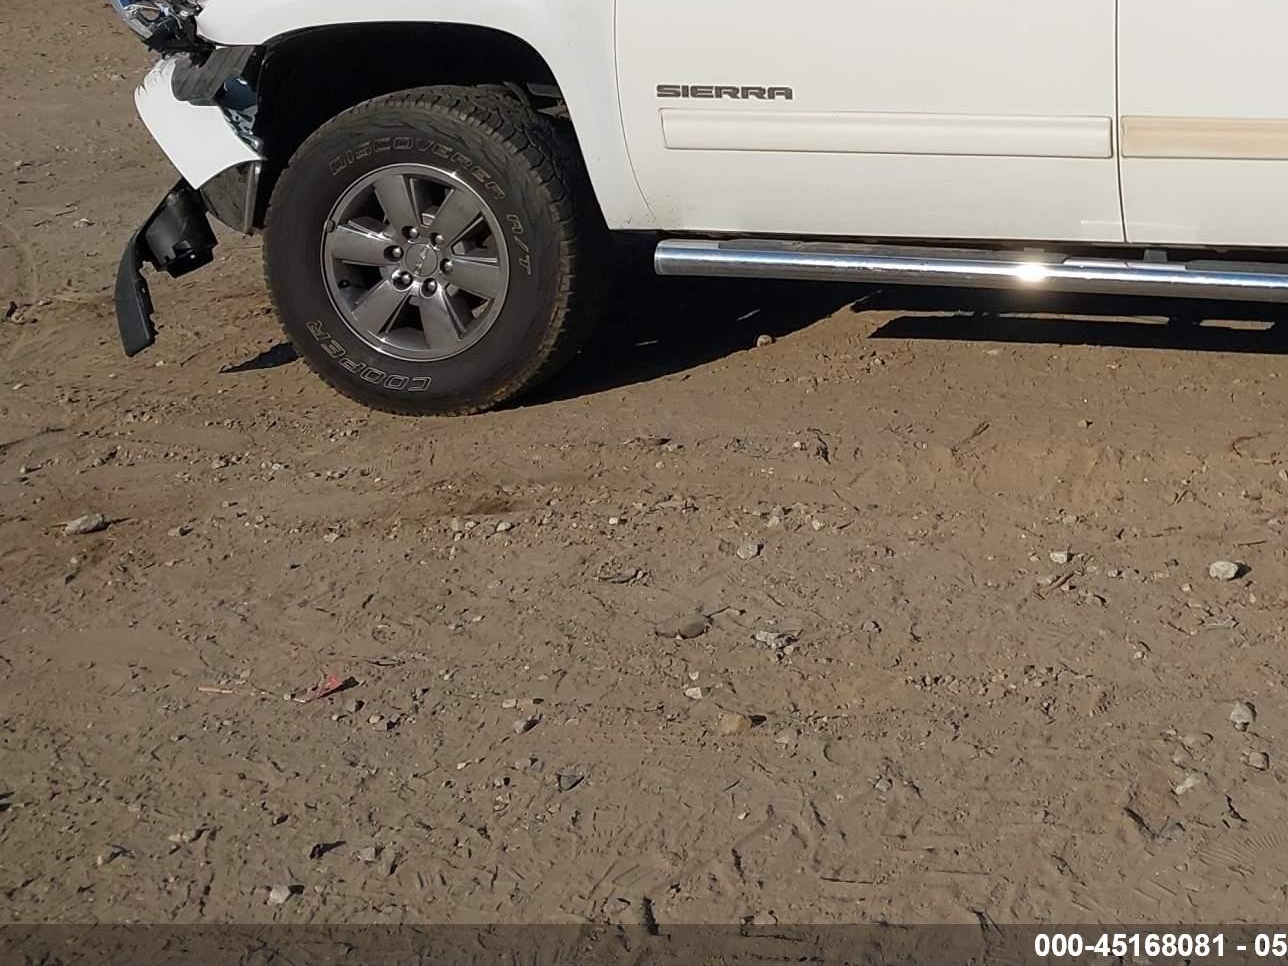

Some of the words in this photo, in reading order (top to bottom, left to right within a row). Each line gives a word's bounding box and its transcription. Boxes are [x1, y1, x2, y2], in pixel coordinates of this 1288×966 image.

[656, 84, 793, 100] SIERRA
[328, 136, 507, 202] DISCOVERER
[506, 213, 533, 275] A/T
[306, 319, 432, 393] COOPER
